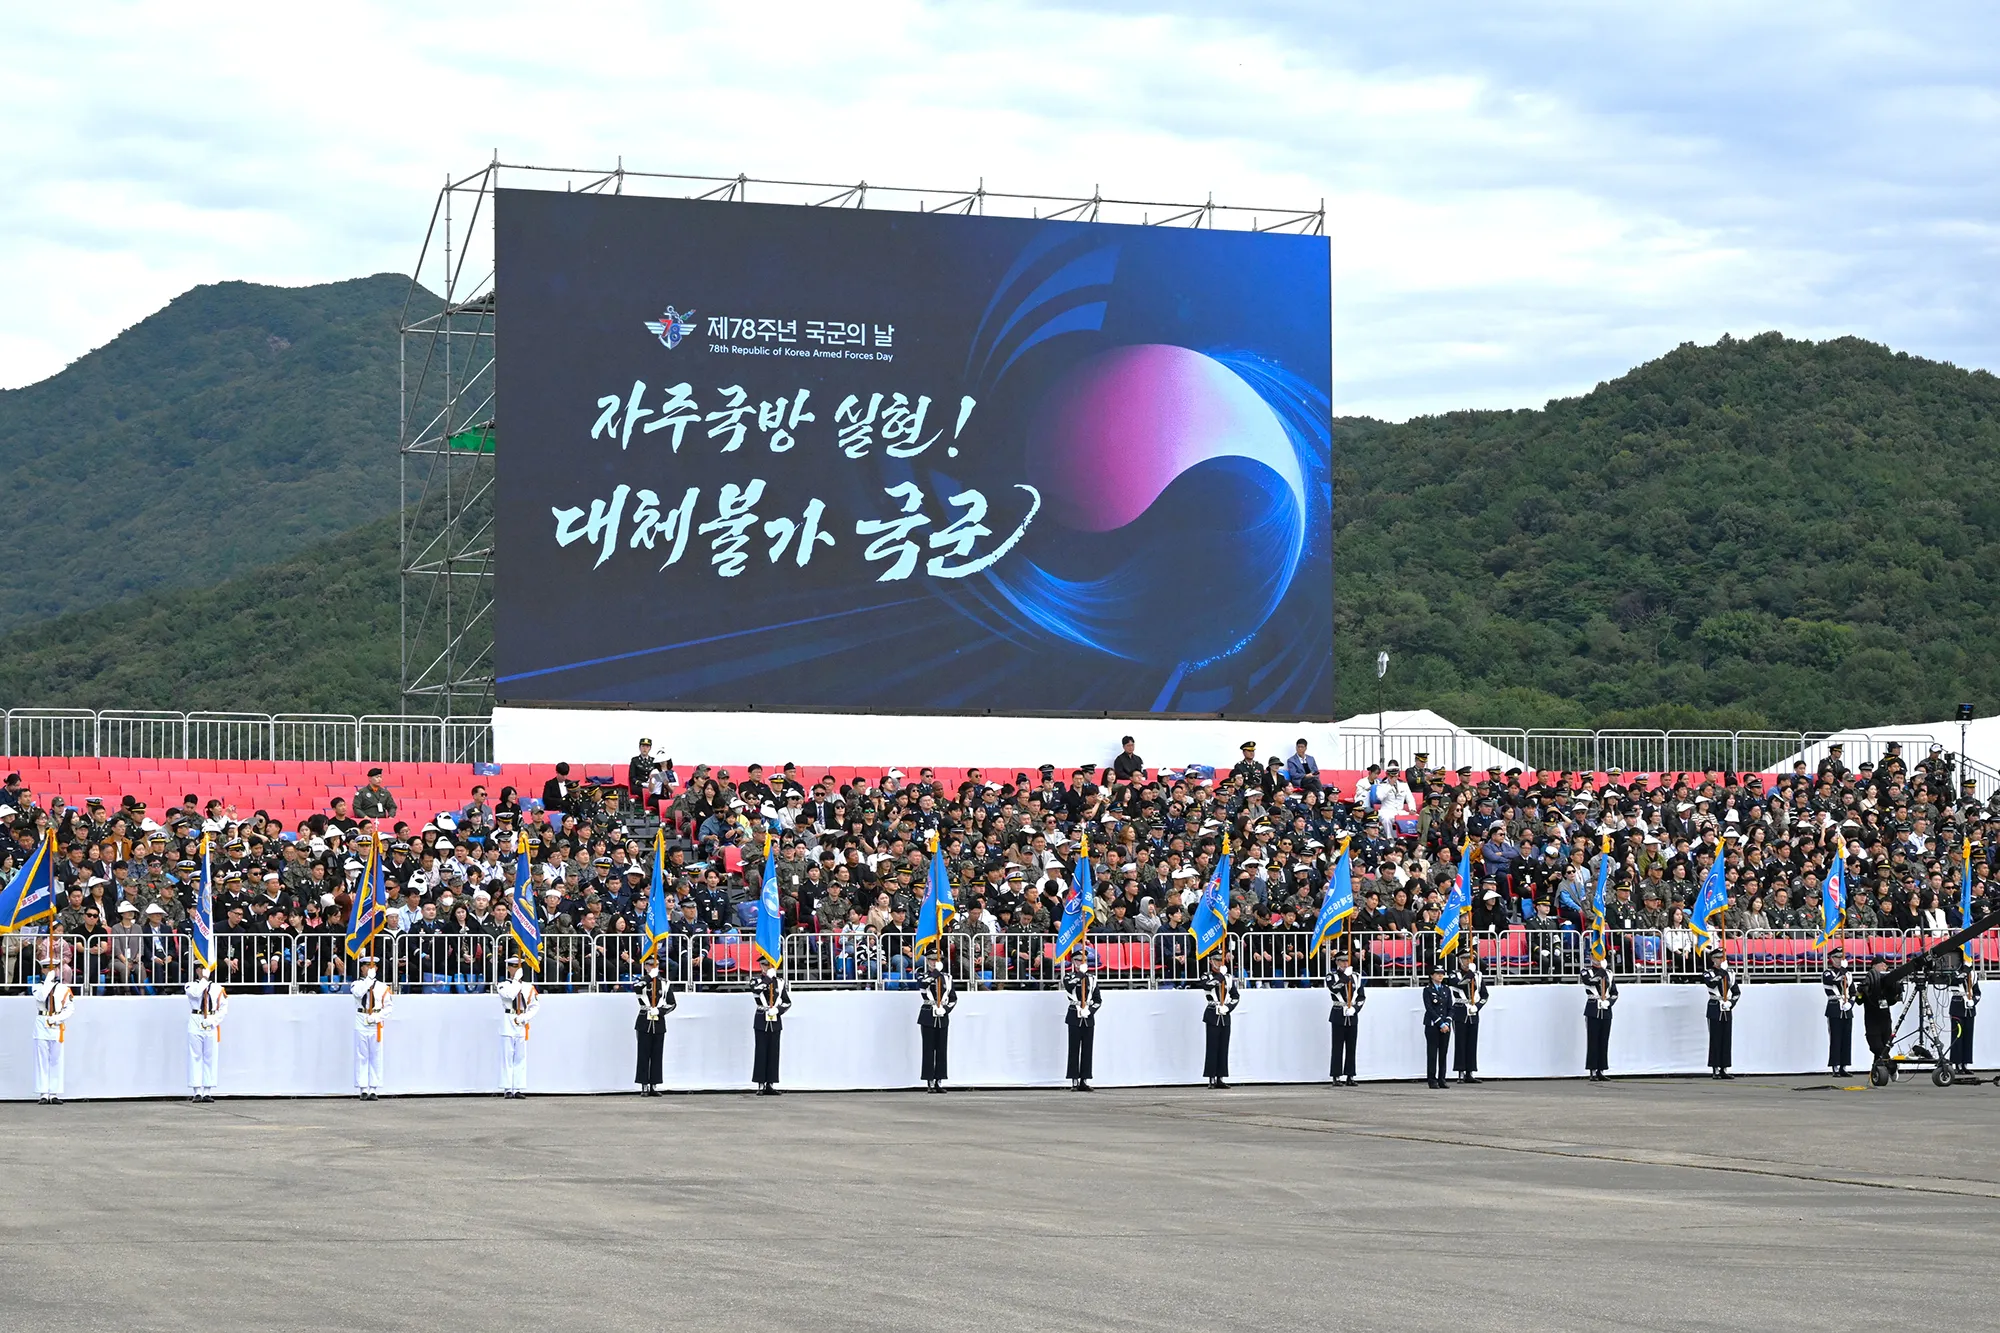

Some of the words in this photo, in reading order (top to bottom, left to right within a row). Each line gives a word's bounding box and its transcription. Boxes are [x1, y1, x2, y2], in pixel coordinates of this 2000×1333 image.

[707, 316, 797, 342] 제78주년
[805, 320, 866, 347] 국군의
[874, 324, 895, 348] 날
[708, 343, 729, 353] 78th
[731, 345, 770, 356] Republic
[772, 346, 782, 356] of
[784, 347, 811, 357] Korea
[812, 349, 842, 359] Armed
[844, 350, 874, 360] Forces
[876, 351, 894, 363] Day
[590, 379, 816, 454] 자주국방
[551, 478, 836, 578] 대체불가
[855, 480, 1042, 582] 국군
